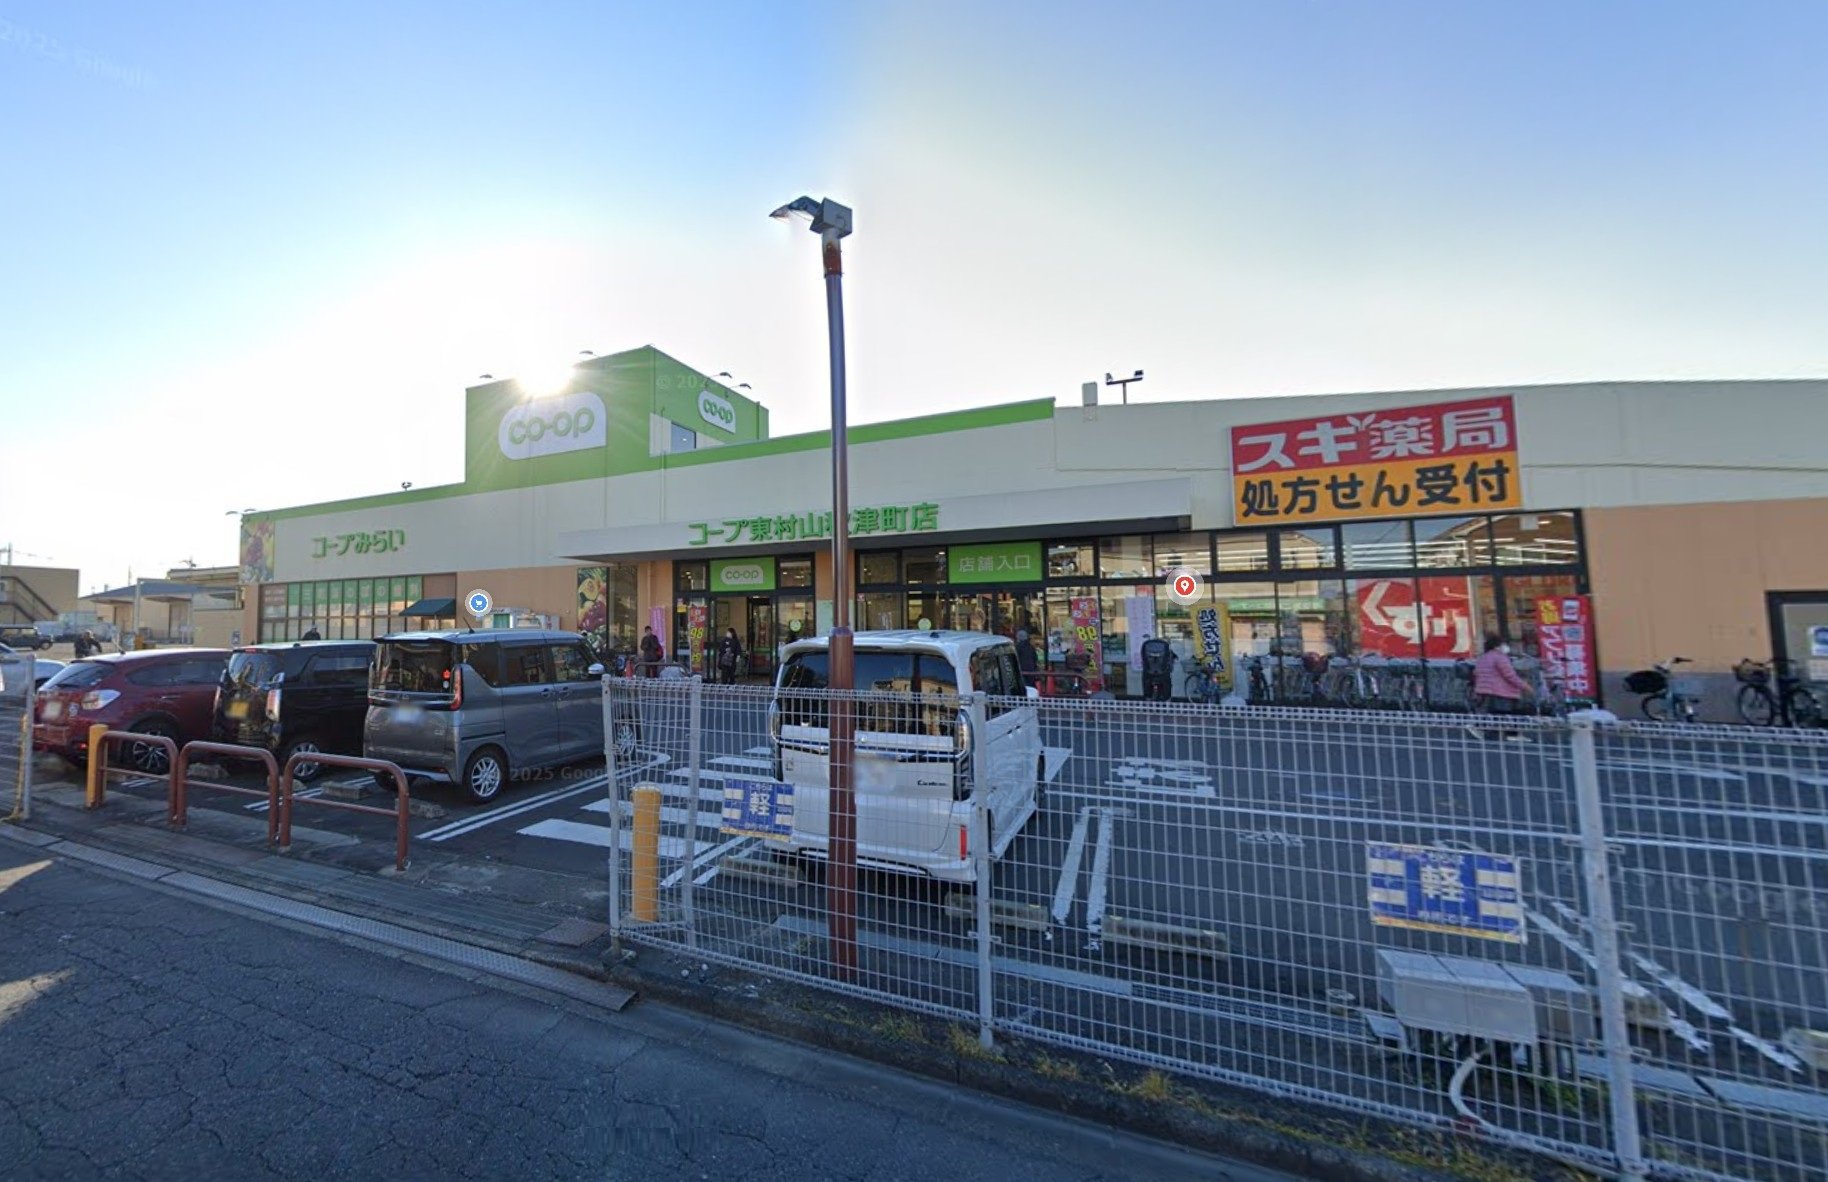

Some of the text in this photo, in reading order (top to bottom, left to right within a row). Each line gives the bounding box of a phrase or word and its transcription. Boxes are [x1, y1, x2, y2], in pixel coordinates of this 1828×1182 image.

[508, 407, 595, 445] co-op
[1237, 406, 1509, 473] スギ薬局
[1241, 459, 1510, 517] 処方せん受付
[311, 529, 405, 558] コープみらい
[960, 555, 1031, 573] 店舗入口
[1361, 580, 1470, 654] くすり
